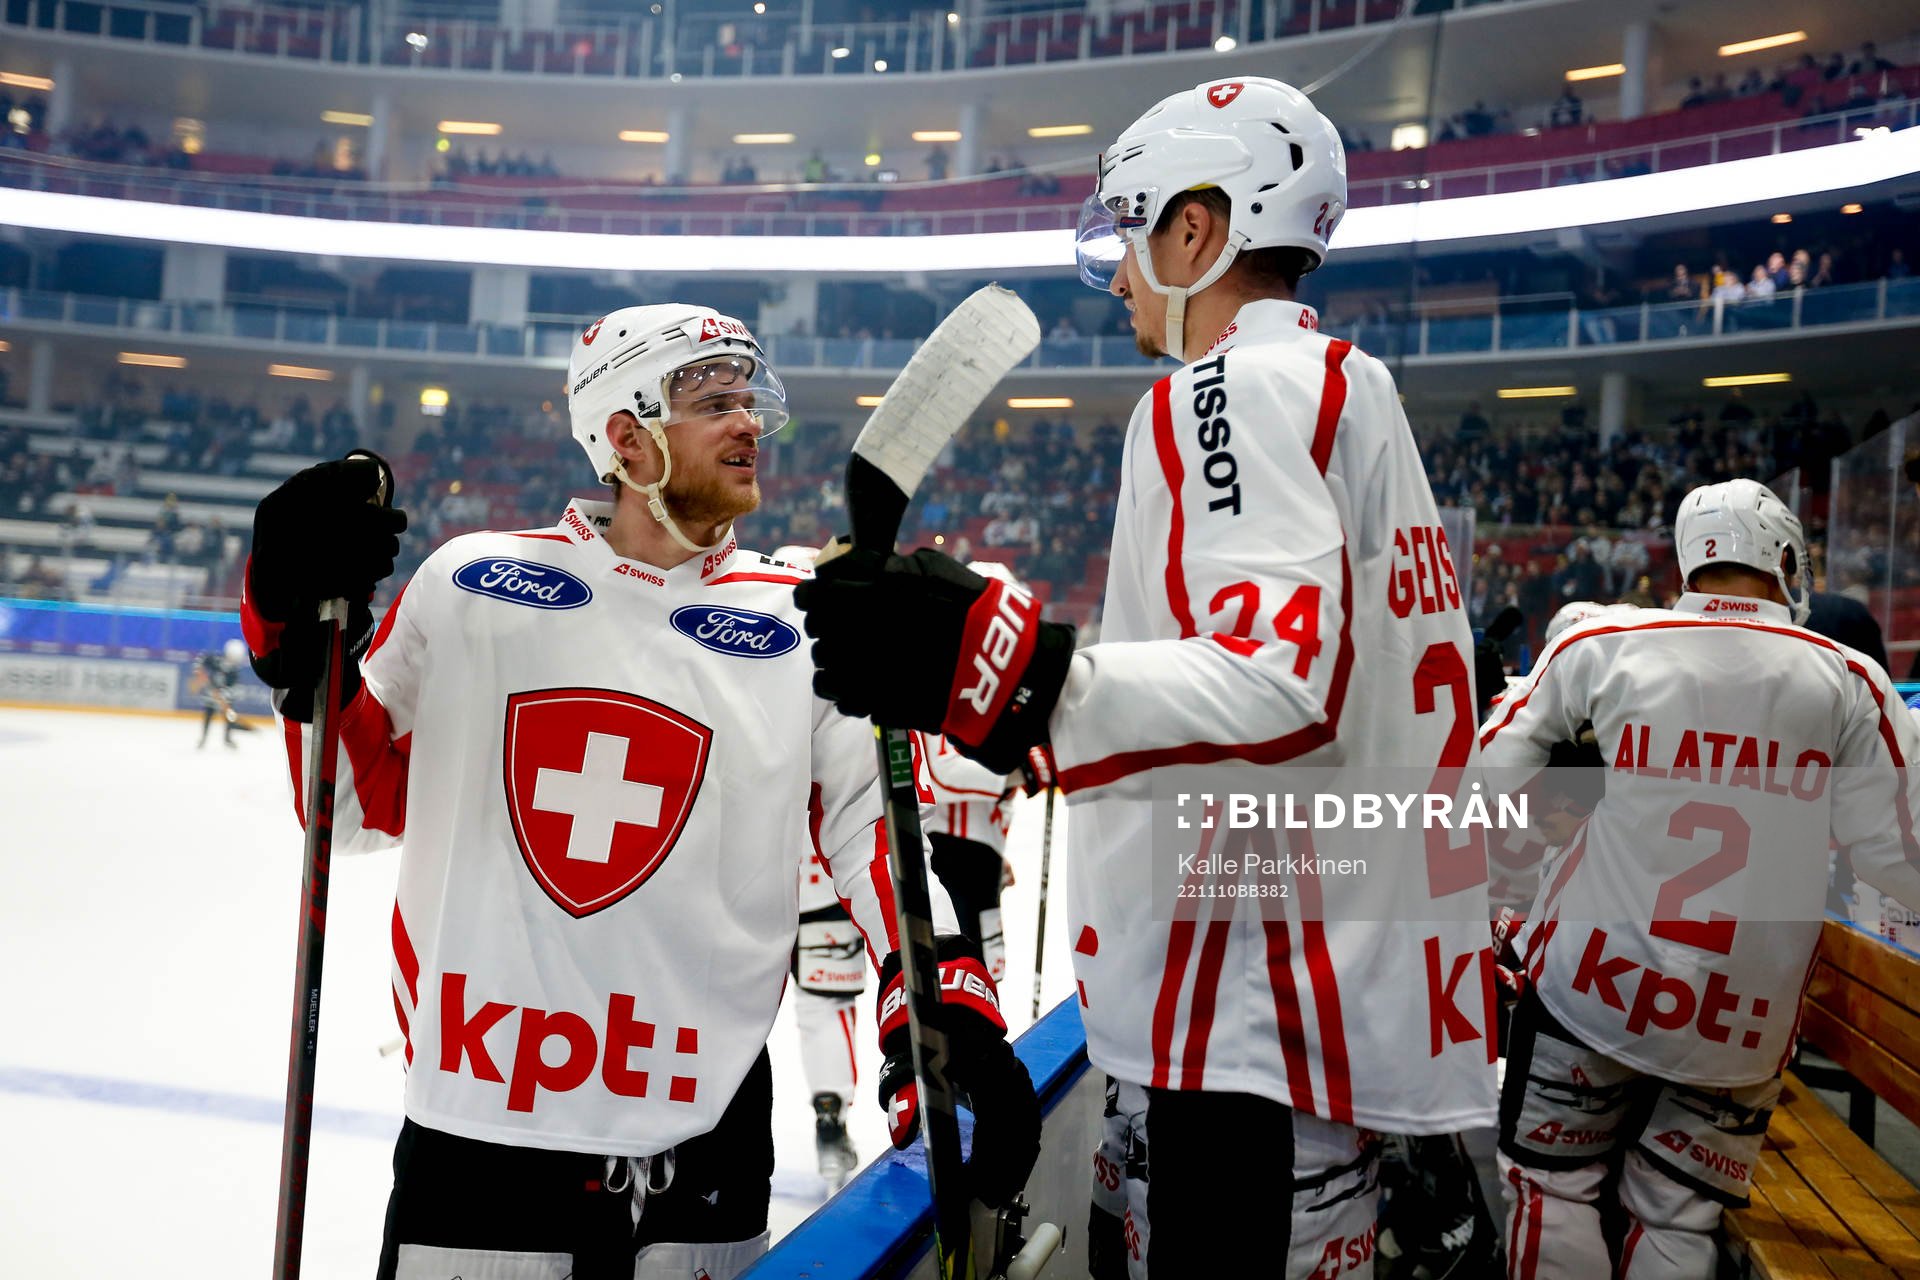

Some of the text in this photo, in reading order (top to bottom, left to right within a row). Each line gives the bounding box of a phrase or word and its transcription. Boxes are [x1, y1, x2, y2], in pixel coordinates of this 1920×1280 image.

[573, 362, 609, 395] BAUER
[1193, 355, 1241, 516] TISSOT
[565, 514, 595, 541] SWISS
[1704, 538, 1717, 558] 2
[715, 538, 736, 566] SWISS
[480, 560, 566, 602] Ford
[629, 568, 666, 588] SWISS
[1721, 601, 1759, 612] SWISS
[695, 610, 777, 651] Ford
[1209, 580, 1323, 680] 24
[1613, 723, 1832, 802] ALATALO
[1649, 801, 1752, 956] 2
[1572, 927, 1770, 1049] kpt:
[307, 988, 318, 1033] MUELLER
[440, 972, 699, 1113] kpt:
[1690, 1144, 1748, 1182] SWISS
